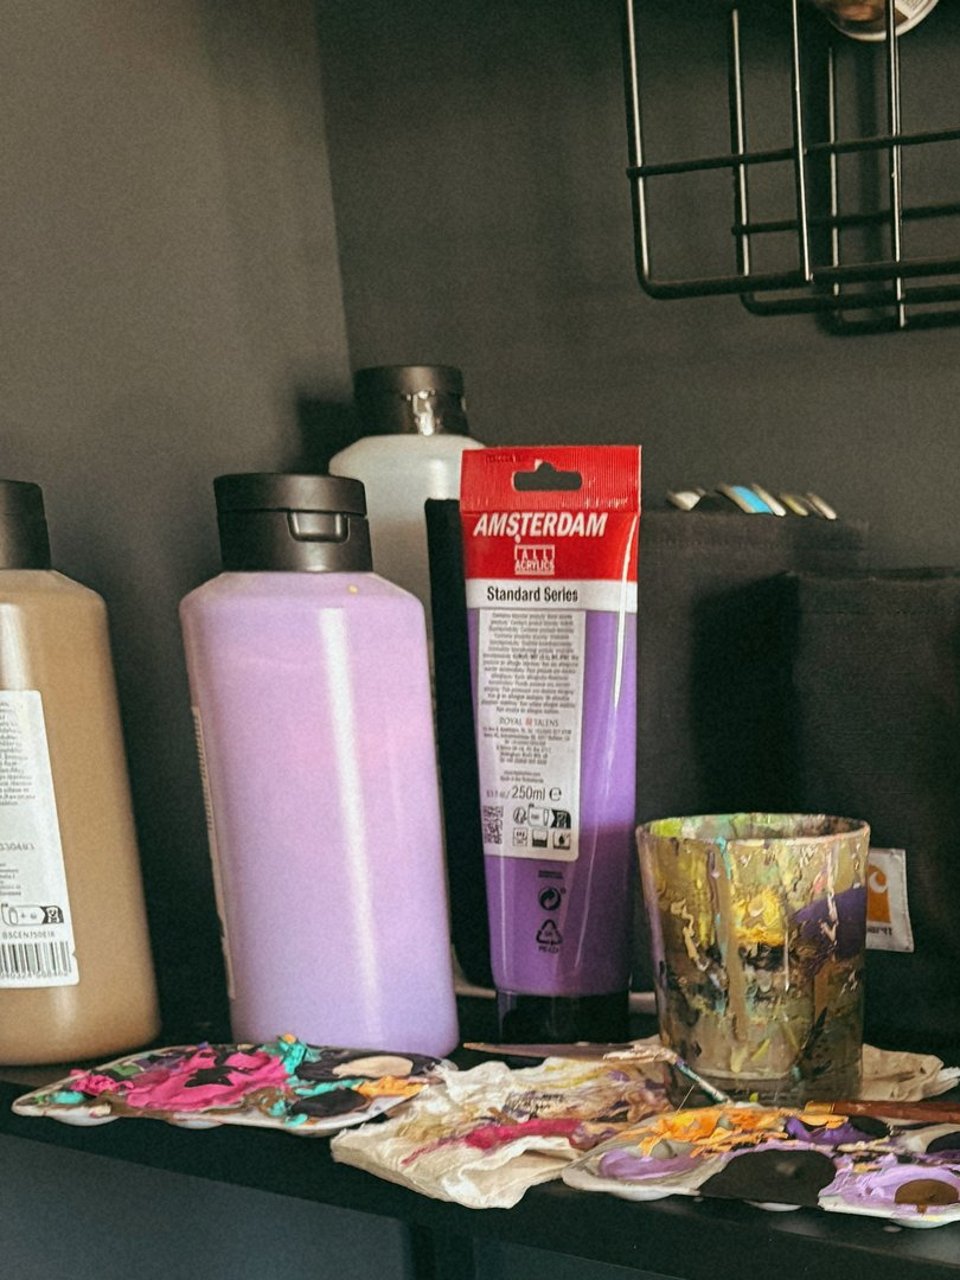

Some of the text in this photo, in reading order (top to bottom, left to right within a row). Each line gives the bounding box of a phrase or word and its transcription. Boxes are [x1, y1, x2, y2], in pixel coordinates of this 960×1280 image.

[472, 512, 608, 537] AMSTERDAM
[486, 586, 579, 602] Standard Series
[511, 785, 546, 802] 250ml
